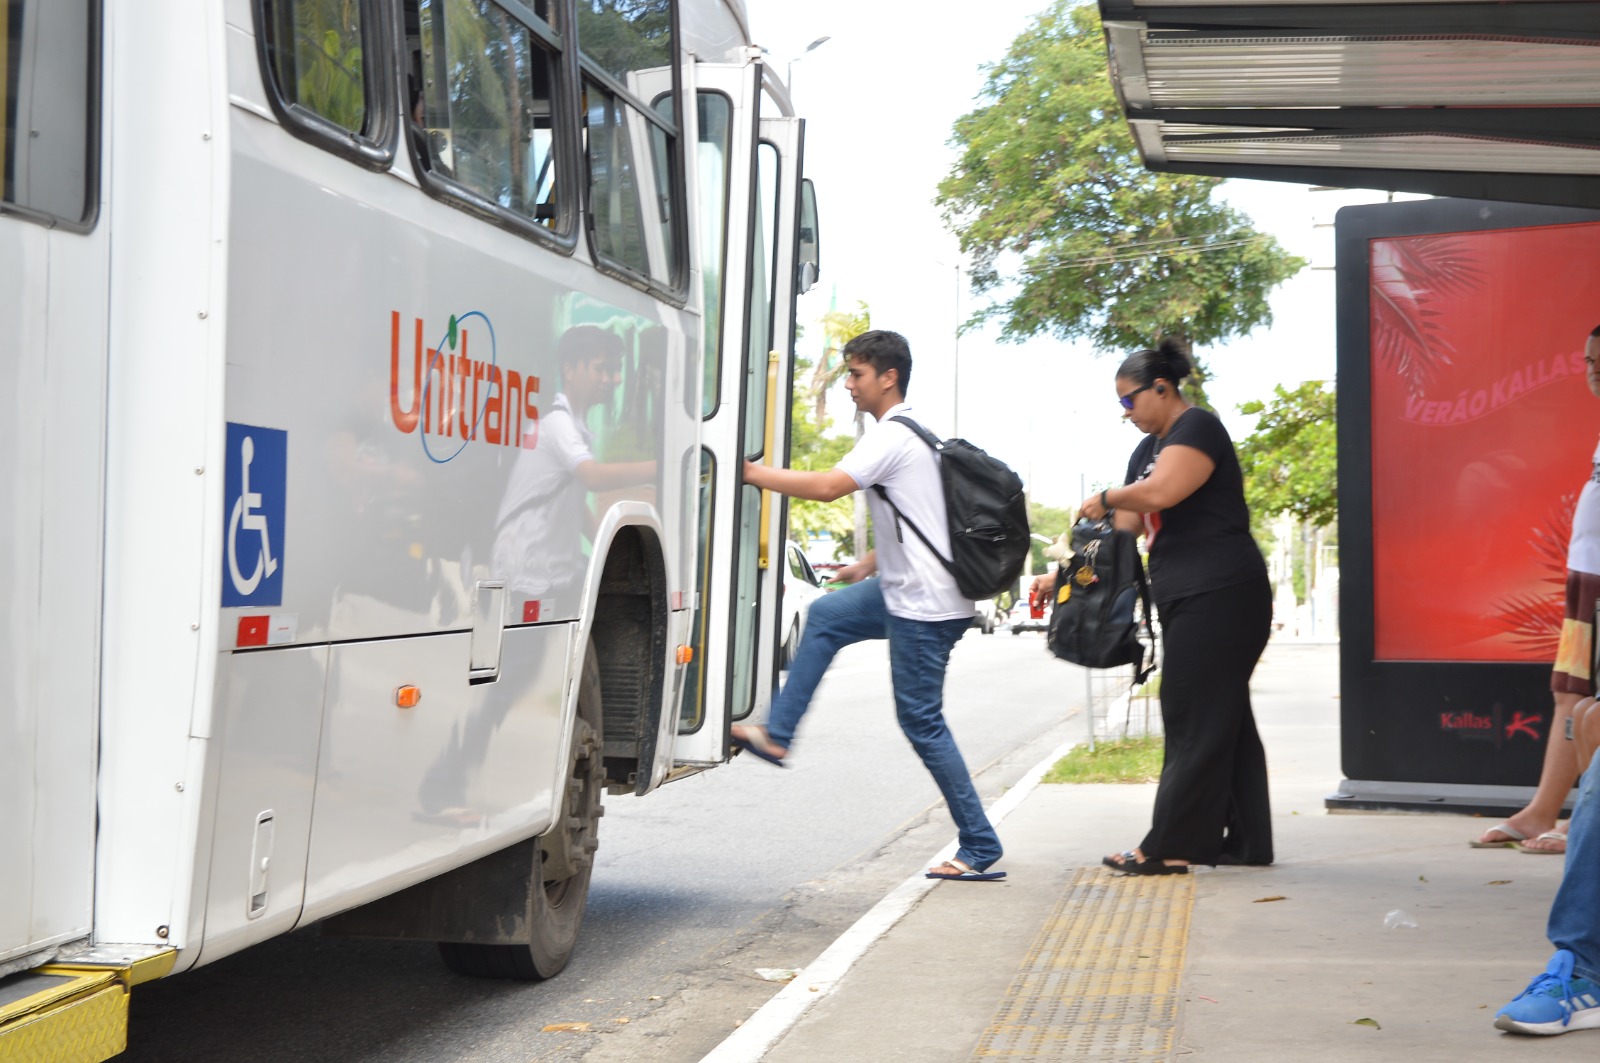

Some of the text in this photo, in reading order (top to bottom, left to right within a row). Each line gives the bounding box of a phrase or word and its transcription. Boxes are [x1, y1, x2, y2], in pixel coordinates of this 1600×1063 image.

[390, 310, 540, 450] Unitrans
[1492, 351, 1586, 409] KALLAS
[1440, 711, 1492, 729] Kallas
